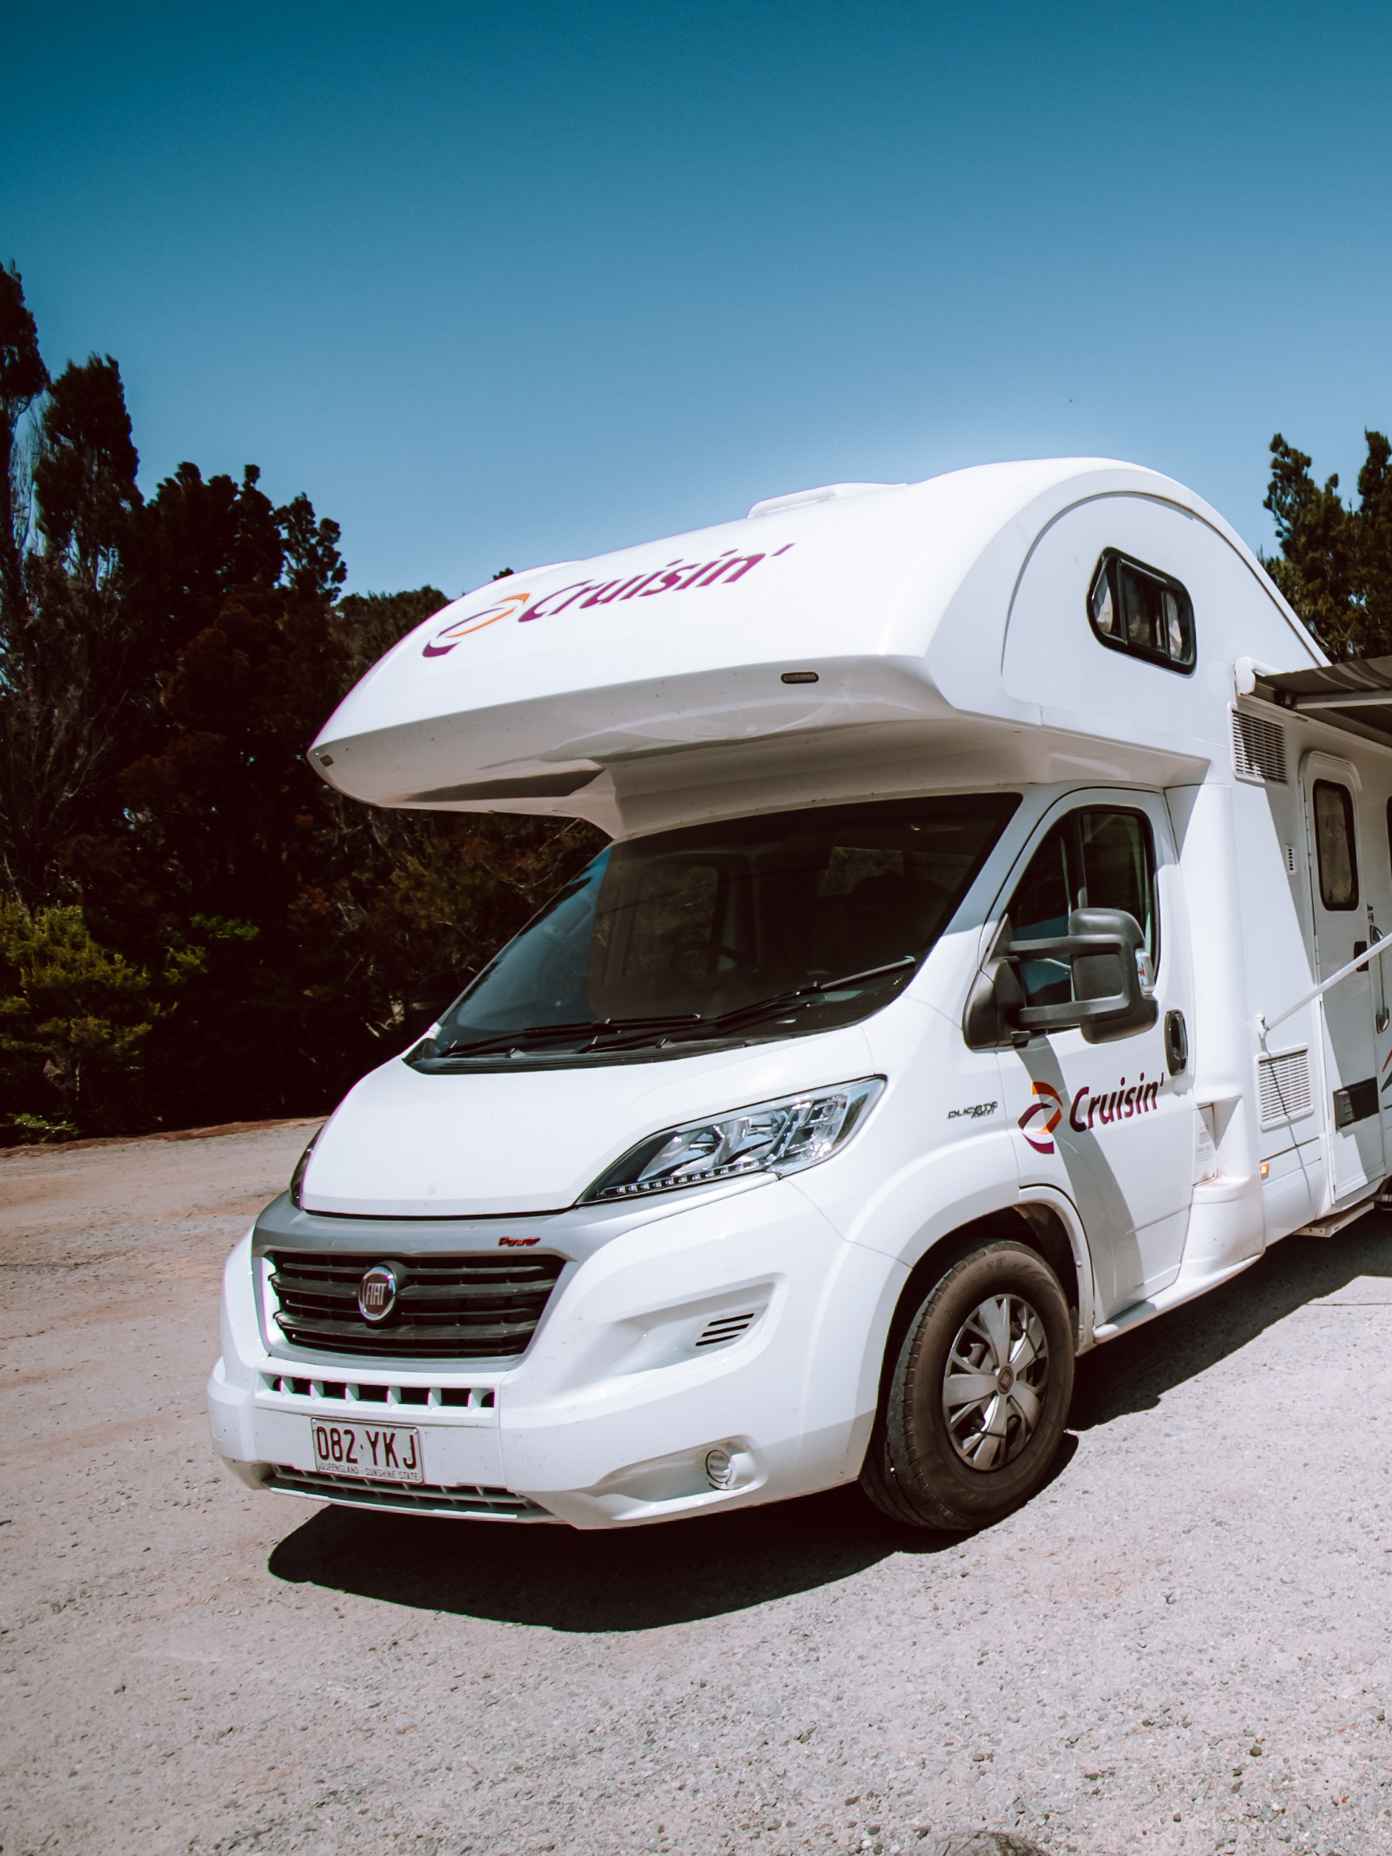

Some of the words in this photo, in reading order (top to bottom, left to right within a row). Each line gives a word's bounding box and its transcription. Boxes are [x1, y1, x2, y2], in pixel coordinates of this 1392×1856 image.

[518, 543, 796, 623] Cruisin'
[1069, 1072, 1164, 1132] Cruisin'
[365, 1282, 387, 1305] FIAT
